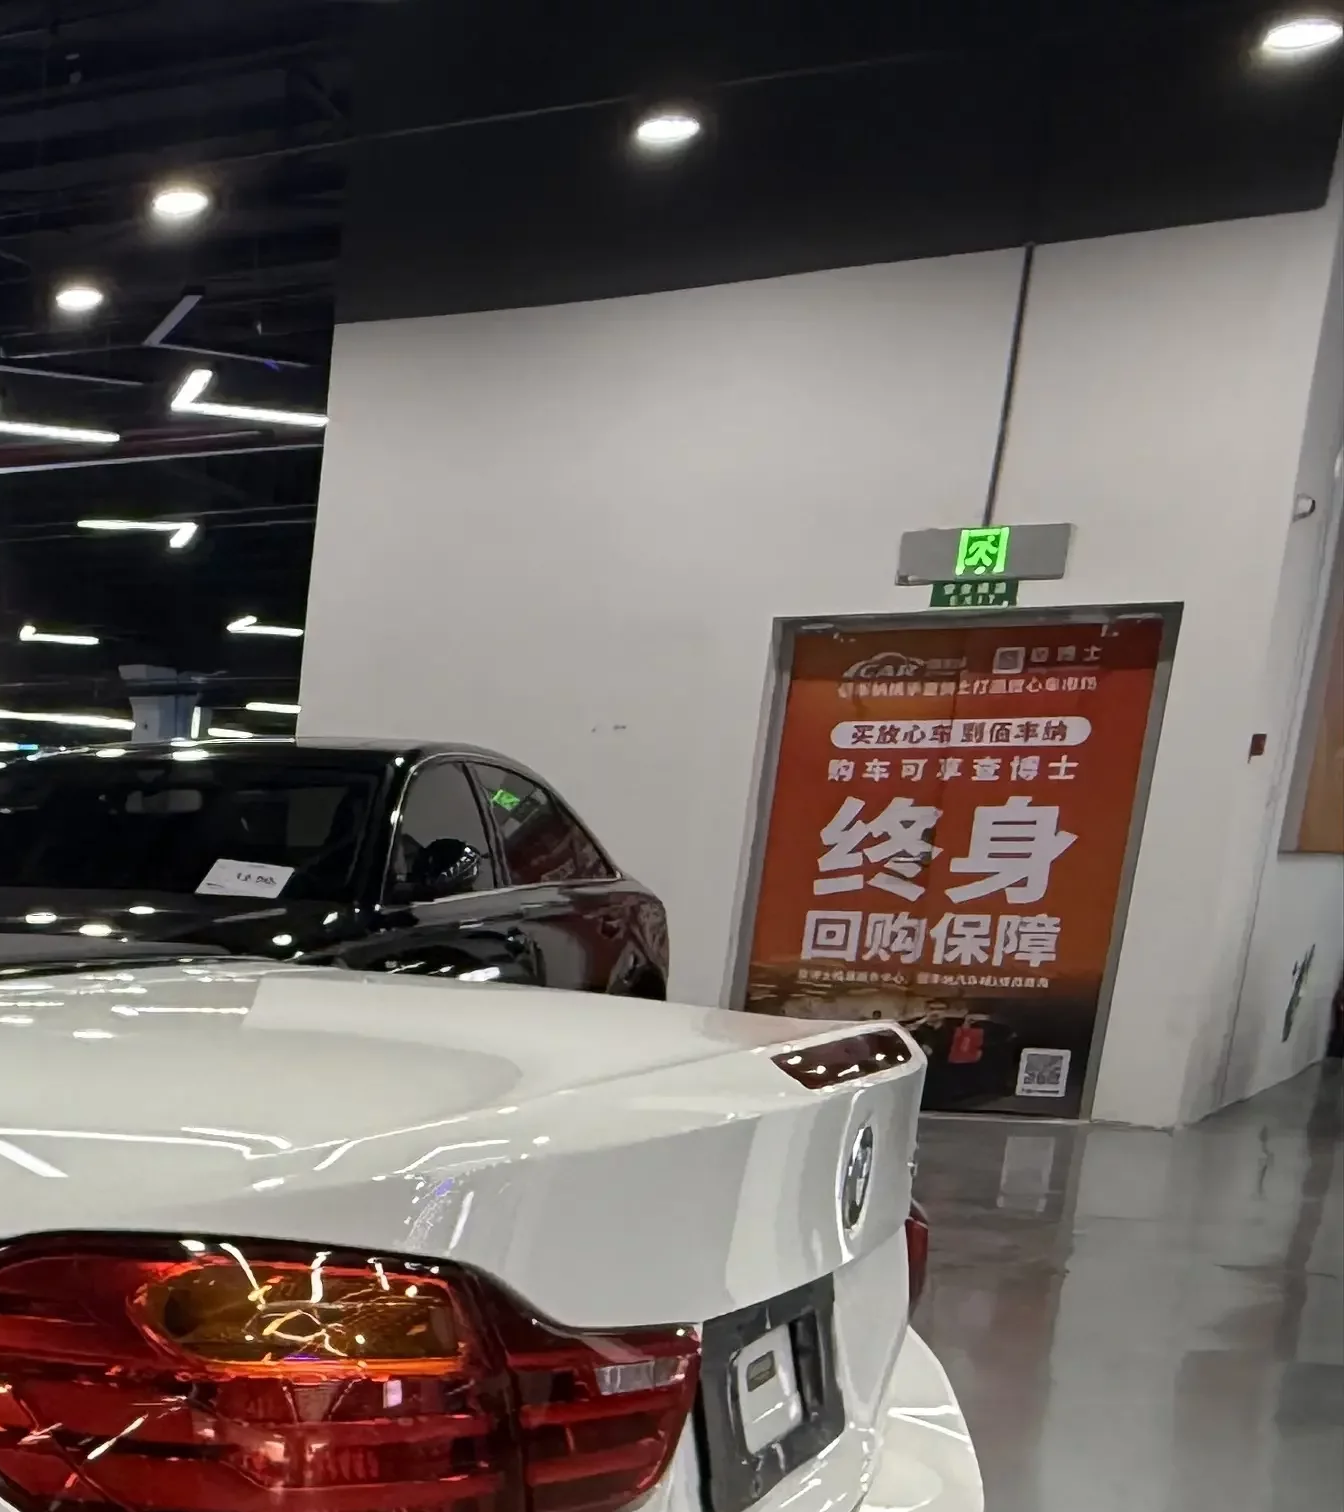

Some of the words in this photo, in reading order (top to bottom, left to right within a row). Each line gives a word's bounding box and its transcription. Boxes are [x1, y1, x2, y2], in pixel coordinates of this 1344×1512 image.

[813, 795, 1079, 904] 终身
[800, 909, 1062, 968] 回购保障
